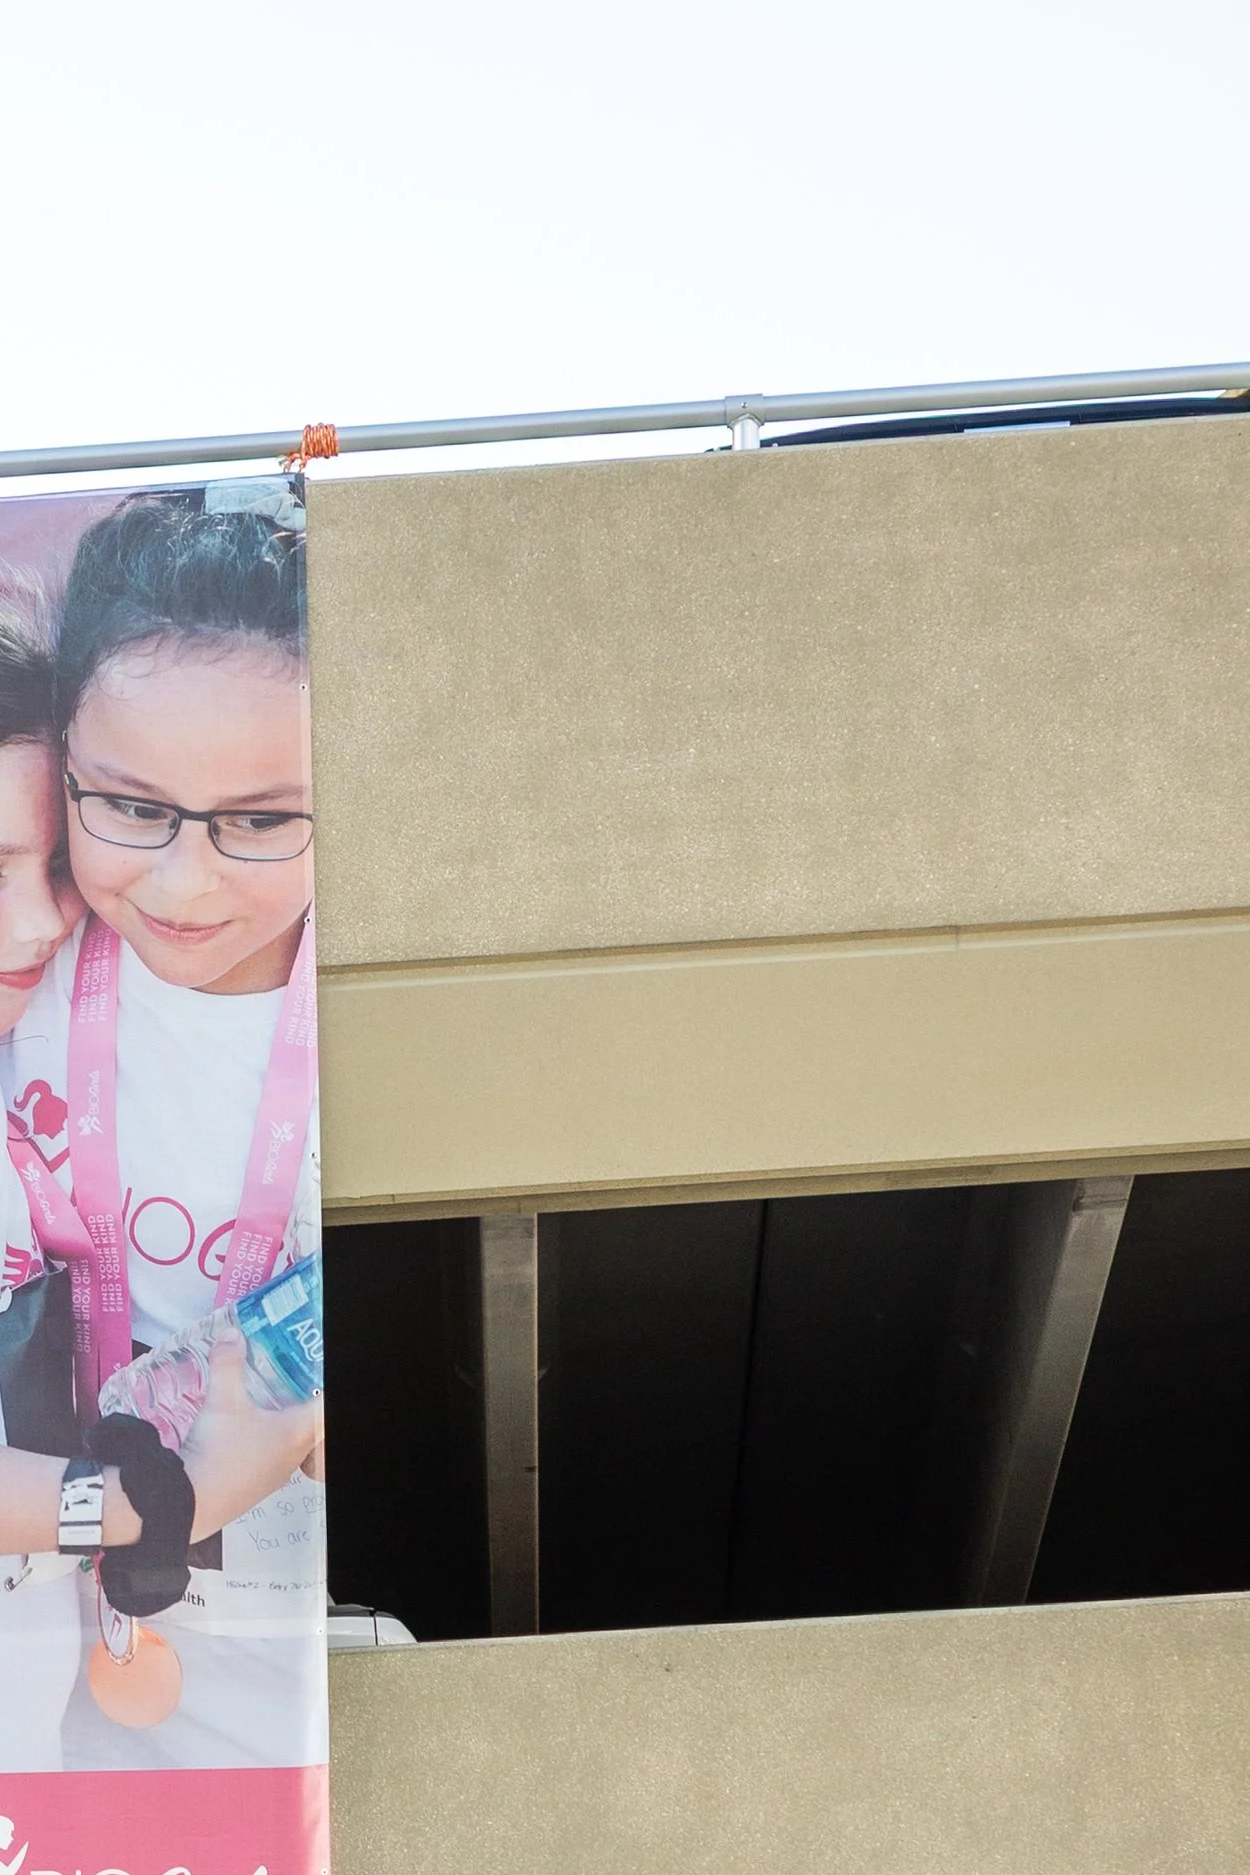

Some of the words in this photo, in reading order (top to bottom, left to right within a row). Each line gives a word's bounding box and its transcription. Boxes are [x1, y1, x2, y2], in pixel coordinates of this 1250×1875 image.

[81, 961, 91, 994] YOUR
[90, 960, 100, 993] YOUR
[100, 959, 110, 992] YOUR
[77, 995, 88, 1023] FIND
[88, 994, 98, 1022] FIND
[98, 992, 108, 1020] FIND
[292, 984, 306, 1015] YOUR
[285, 1016, 299, 1044] KIND
[87, 1215, 101, 1245] KIND
[96, 1214, 109, 1244] KIND
[105, 1214, 117, 1243] KIND
[237, 1231, 252, 1259] FIND
[246, 1233, 262, 1262] FIND
[257, 1235, 274, 1264] FIND
[80, 1259, 91, 1285] FIND
[96, 1247, 106, 1280] YOUR
[103, 1247, 113, 1280] YOUR
[111, 1246, 121, 1280] YOUR
[226, 1263, 244, 1295] YOUR
[236, 1264, 254, 1296] YOUR
[72, 1287, 81, 1320] YOUR
[81, 1287, 91, 1320] YOUR
[100, 1283, 109, 1312] FIND
[108, 1283, 116, 1312] FIND
[115, 1283, 124, 1312] FIND
[82, 1323, 90, 1353] KIND
[247, 1529, 282, 1552] You
[286, 1529, 311, 1546] are
